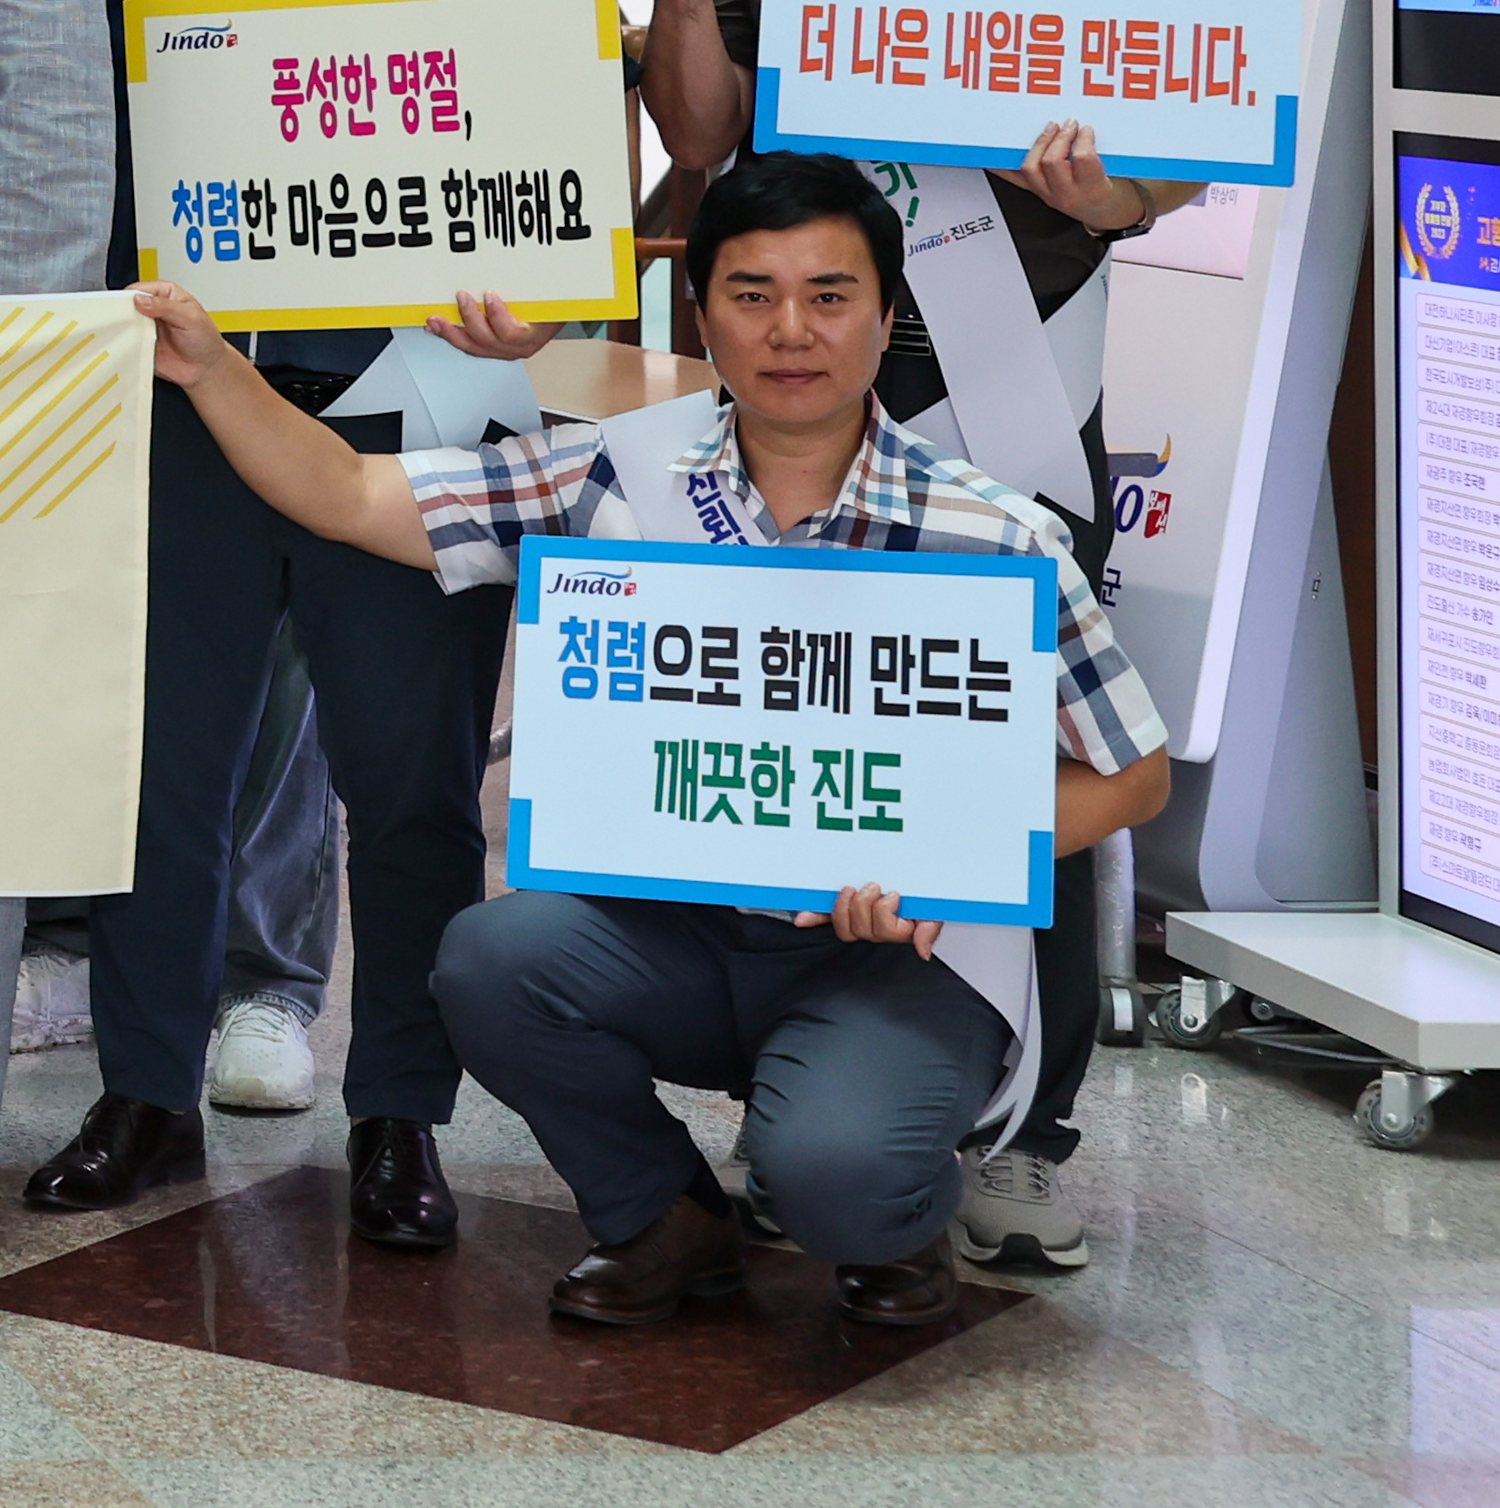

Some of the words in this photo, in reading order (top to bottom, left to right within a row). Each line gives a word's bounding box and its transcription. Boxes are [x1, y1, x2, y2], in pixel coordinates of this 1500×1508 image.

[156, 26, 225, 54] Jindo
[799, 2, 835, 82] 더
[850, 4, 931, 87] 나은
[942, 9, 1066, 97] 내일을
[1079, 17, 1257, 107] 만듭니다.
[270, 53, 377, 143] 풍성한
[387, 47, 473, 141] 명절,
[171, 177, 277, 263] 청렴한
[287, 173, 433, 259] 마음으로
[441, 167, 592, 253] 함께해요
[546, 569, 624, 598] Jindo
[556, 615, 742, 707] 청렴으로
[760, 626, 852, 716] 함께
[868, 632, 1012, 722] 만드는
[653, 737, 795, 828] 깨끗한
[809, 746, 904, 832] 진도
